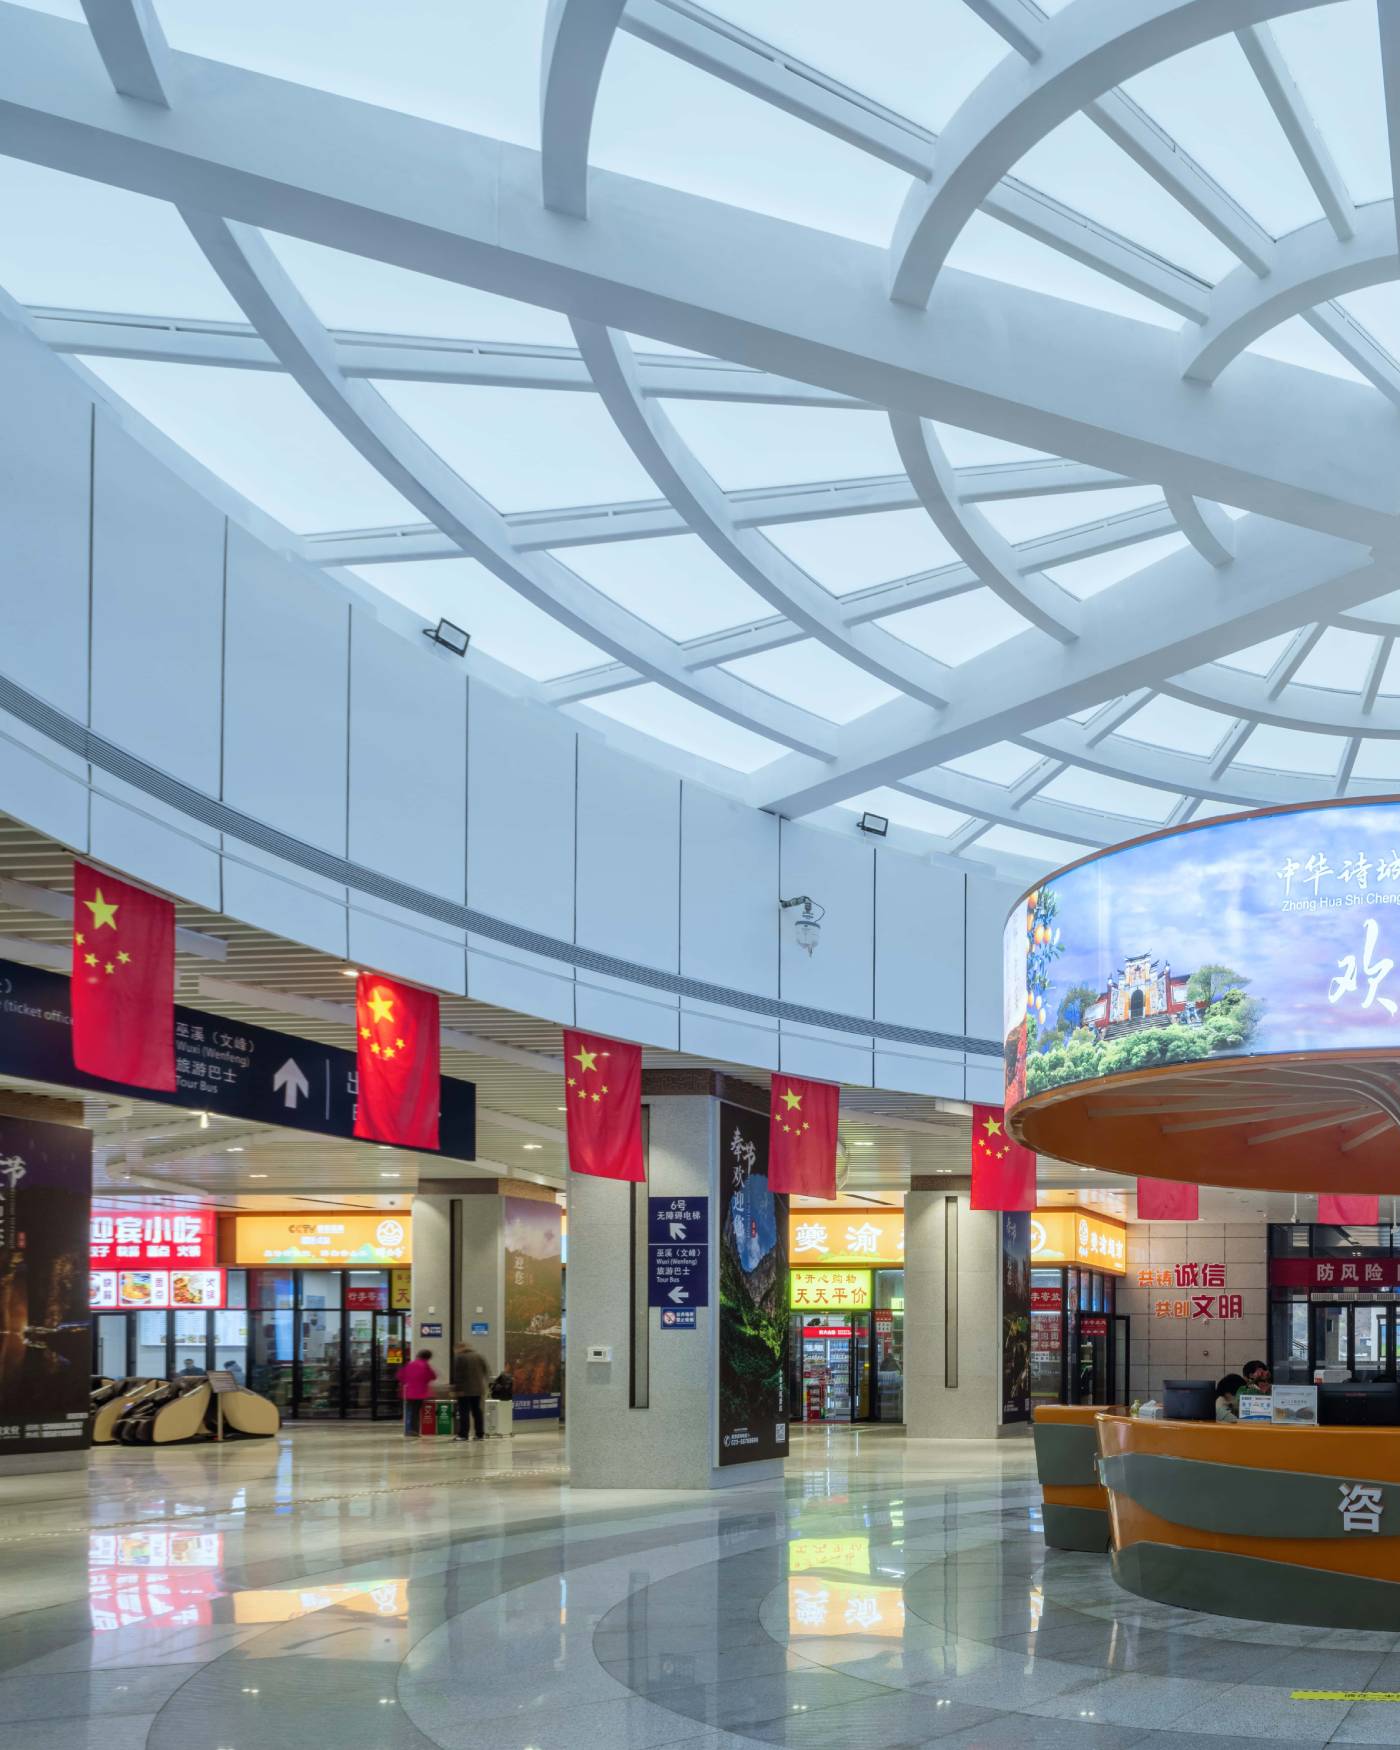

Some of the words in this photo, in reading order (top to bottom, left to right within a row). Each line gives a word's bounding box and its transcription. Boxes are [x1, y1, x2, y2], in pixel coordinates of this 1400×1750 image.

[1281, 898, 1317, 913] Zhong
[1319, 896, 1343, 908] Hua
[1345, 893, 1364, 906] Shi
[202, 1045, 250, 1070] (Wenfeng)
[176, 1057, 238, 1084] 旅游巴士
[199, 1080, 218, 1094] Bus
[670, 1199, 688, 1212] 6号
[656, 1211, 701, 1221] 无障碍电梯
[288, 1224, 317, 1233] CCTV
[656, 1266, 691, 1276] 旅游巴士
[1137, 1262, 1226, 1289] 共铸诚信
[1316, 1263, 1384, 1282] 防风险
[794, 1287, 868, 1305] 天天平价
[1155, 1293, 1243, 1320] 共创文明
